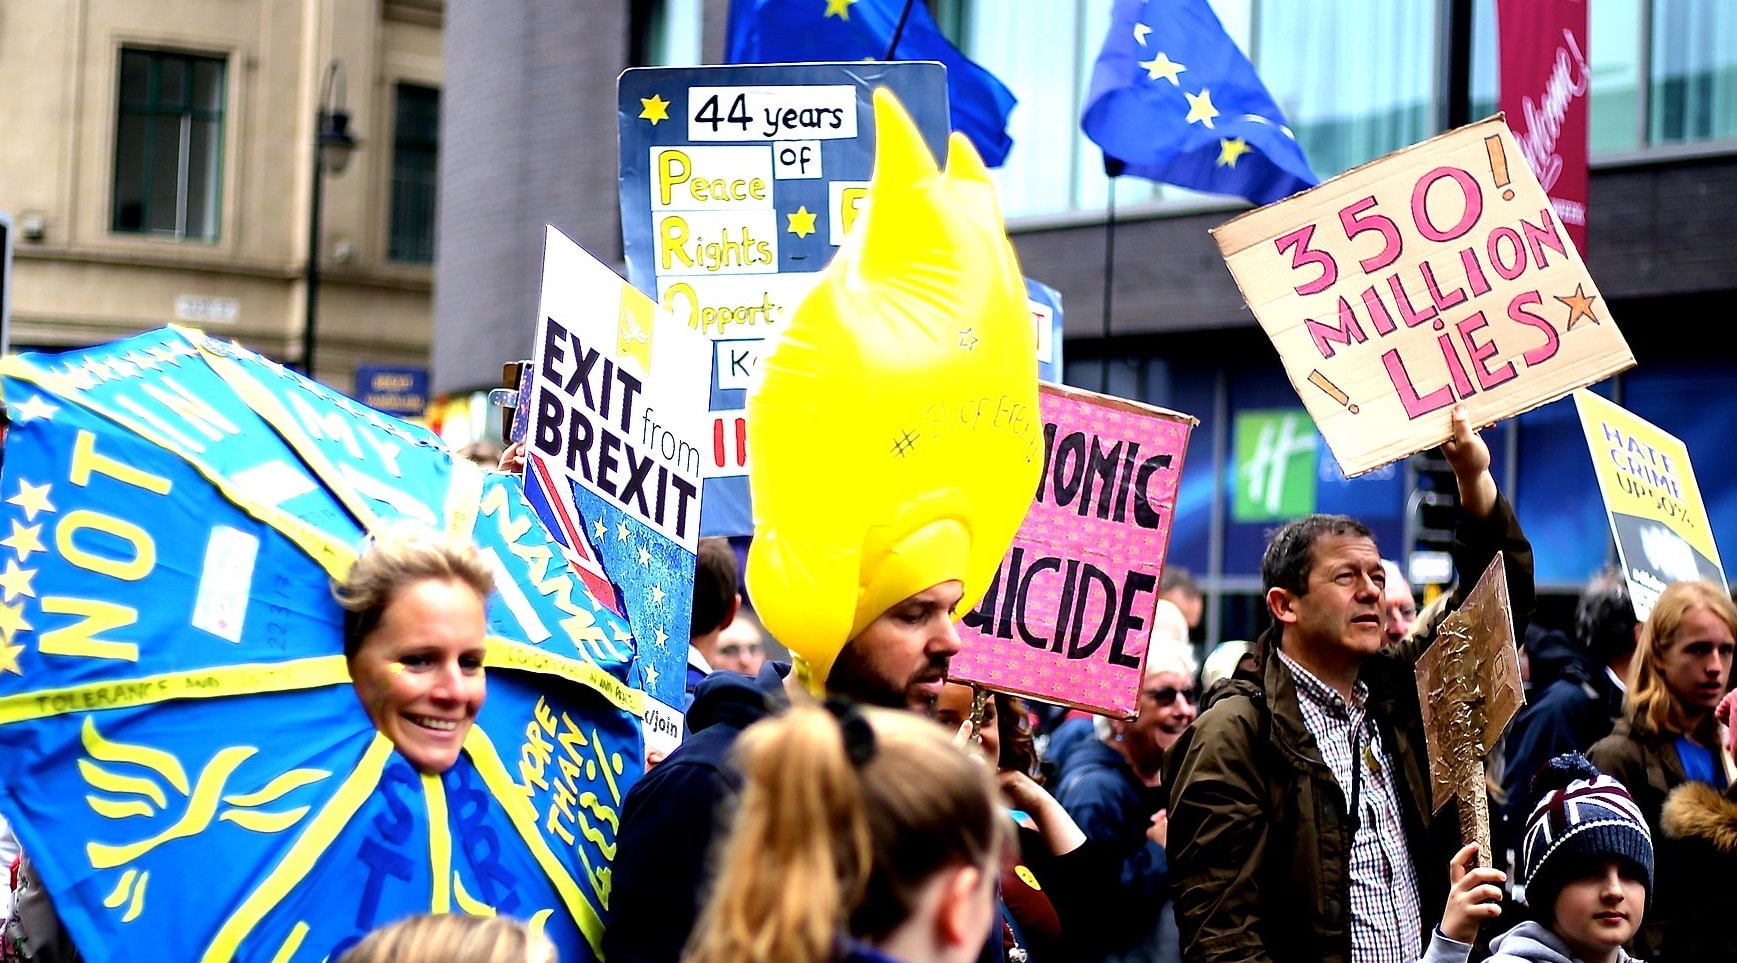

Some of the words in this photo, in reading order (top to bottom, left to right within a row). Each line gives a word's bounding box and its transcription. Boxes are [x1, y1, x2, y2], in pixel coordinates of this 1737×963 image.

[694, 94, 753, 133] 44
[763, 101, 843, 137] years
[657, 149, 766, 206] Peace
[780, 146, 811, 175] of
[660, 215, 772, 273] Rights
[663, 282, 783, 335] Opport
[1304, 208, 1568, 359] MILLION
[542, 316, 642, 435] EXIT
[642, 407, 700, 479] from
[534, 386, 697, 540] BREXIT
[1602, 422, 1680, 479] HATE
[1610, 449, 1687, 504] CRIME
[38, 429, 172, 663] NOT
[114, 375, 241, 455] IN
[286, 390, 402, 480] MY
[479, 482, 629, 667] NAME
[518, 695, 558, 822] MORE
[547, 711, 588, 846] THAN
